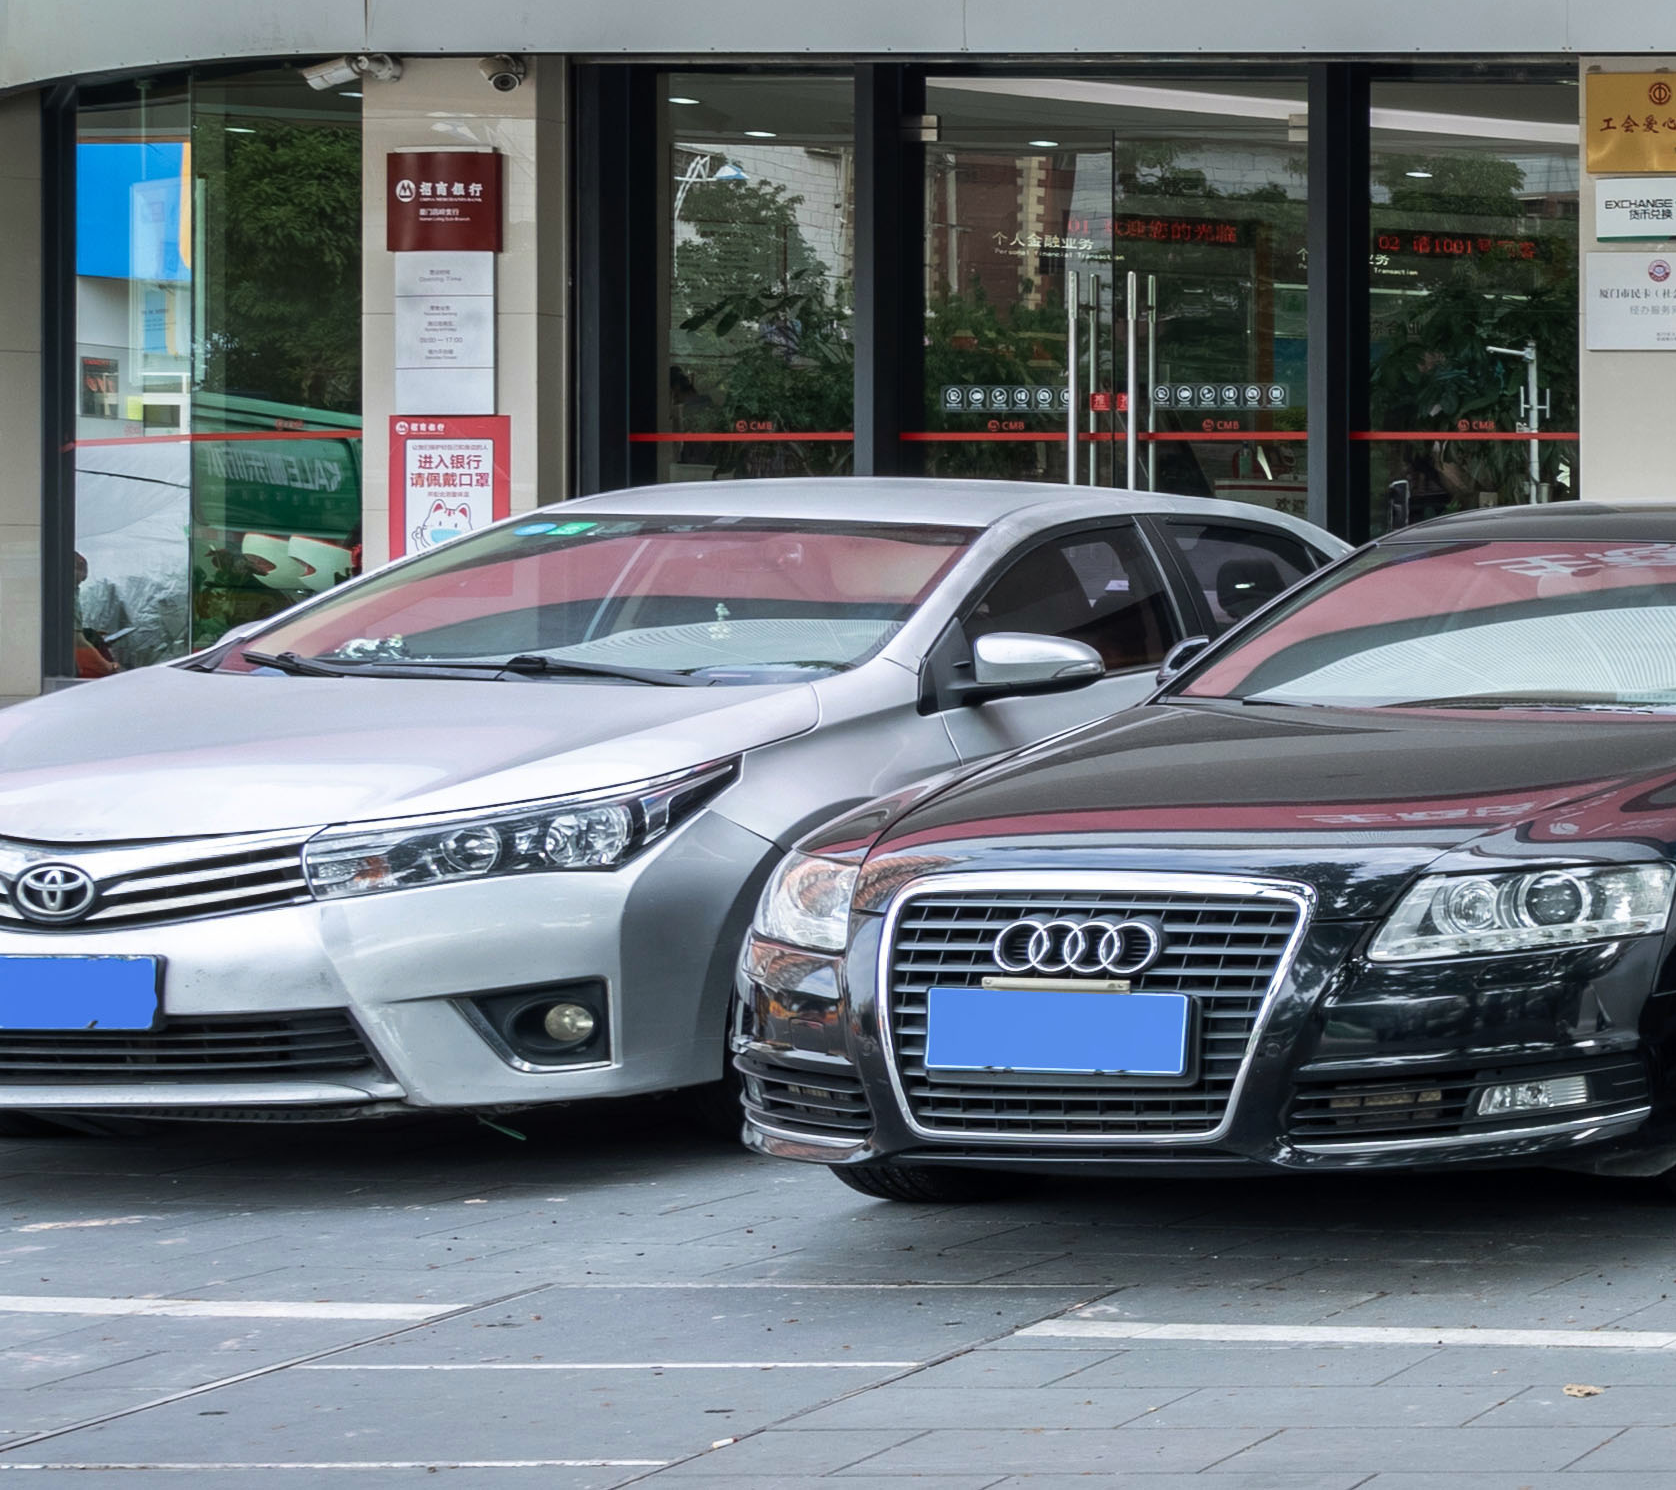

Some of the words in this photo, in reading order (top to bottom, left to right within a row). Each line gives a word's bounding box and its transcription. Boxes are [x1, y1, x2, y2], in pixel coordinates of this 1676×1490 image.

[419, 182, 483, 196] 招商银行
[1604, 199, 1673, 209] EXCHANGE
[1629, 209, 1673, 220] 货币兑换
[992, 231, 1095, 250] 个人金融业务
[750, 422, 773, 431] CMB
[1002, 421, 1025, 430] CMB
[1217, 421, 1240, 430] CMB
[1472, 420, 1496, 429] CMB
[418, 454, 482, 470] 进入银行
[410, 472, 490, 488] 请佩戴口罩
